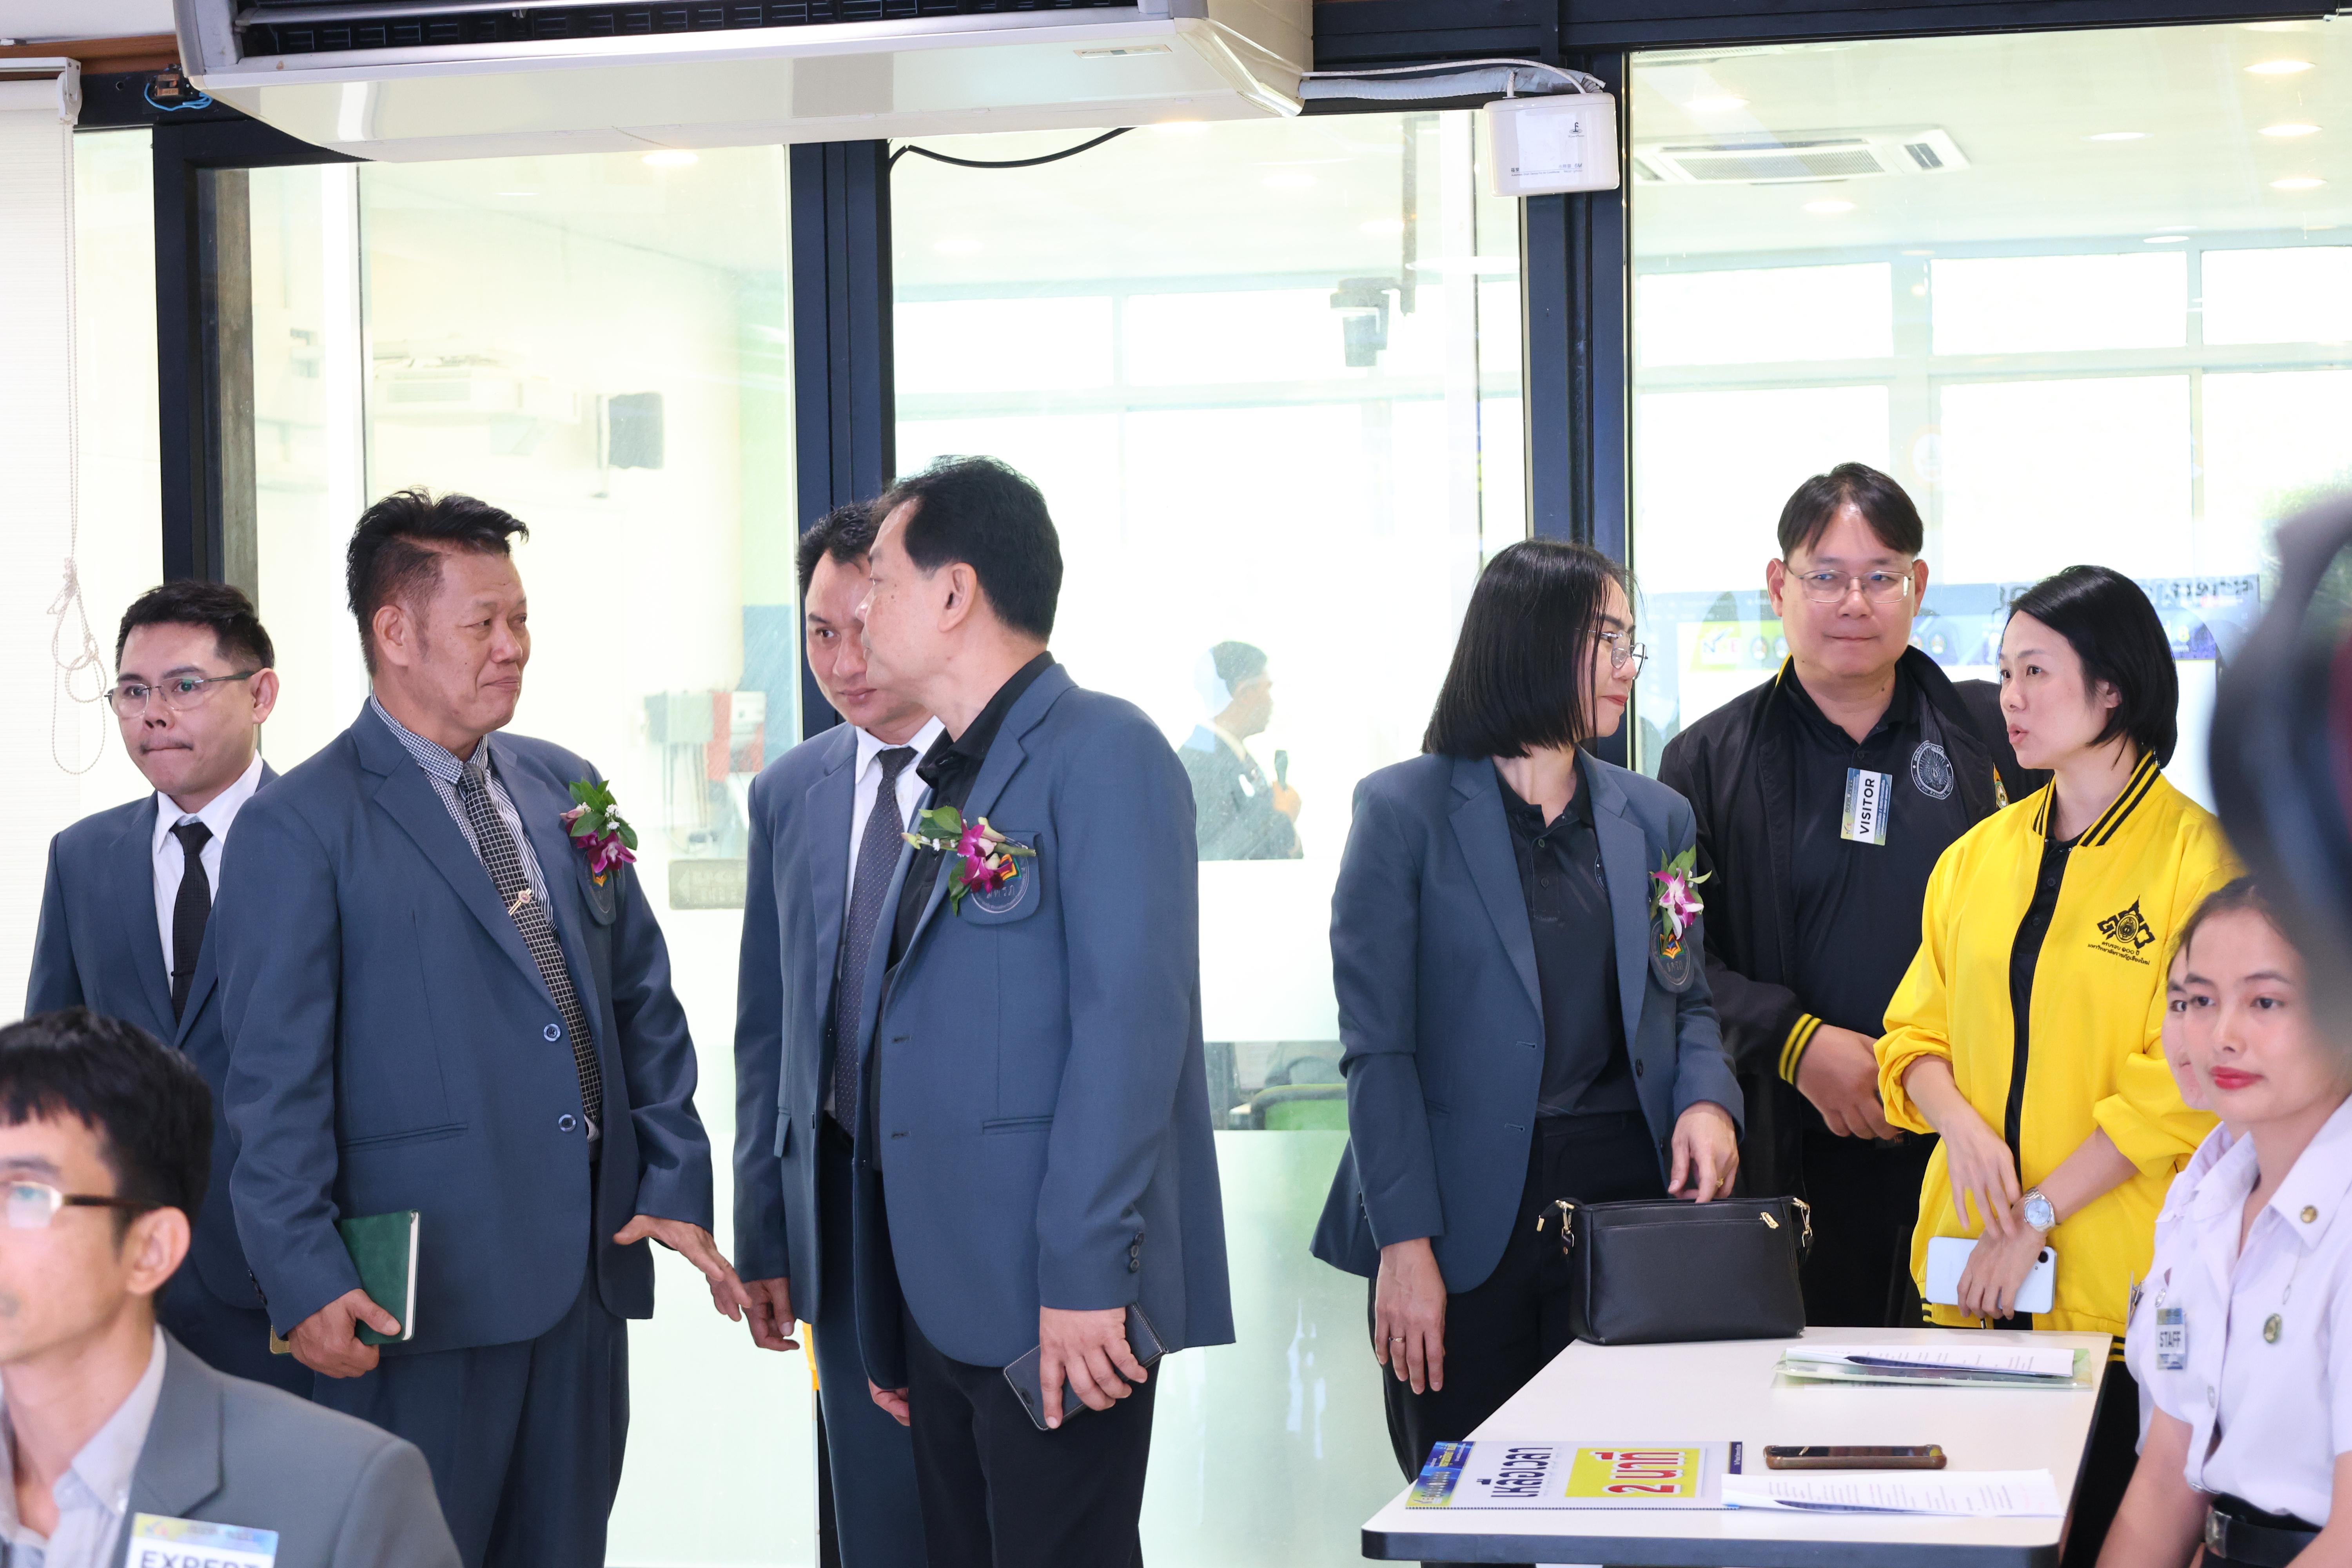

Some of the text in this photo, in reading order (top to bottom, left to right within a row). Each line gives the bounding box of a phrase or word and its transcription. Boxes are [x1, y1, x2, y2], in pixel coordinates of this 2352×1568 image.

[1860, 778, 1875, 835] VISITOR
[1476, 1447, 1553, 1497] เหลือเวลา
[1594, 1452, 1681, 1493] 2 นาที
